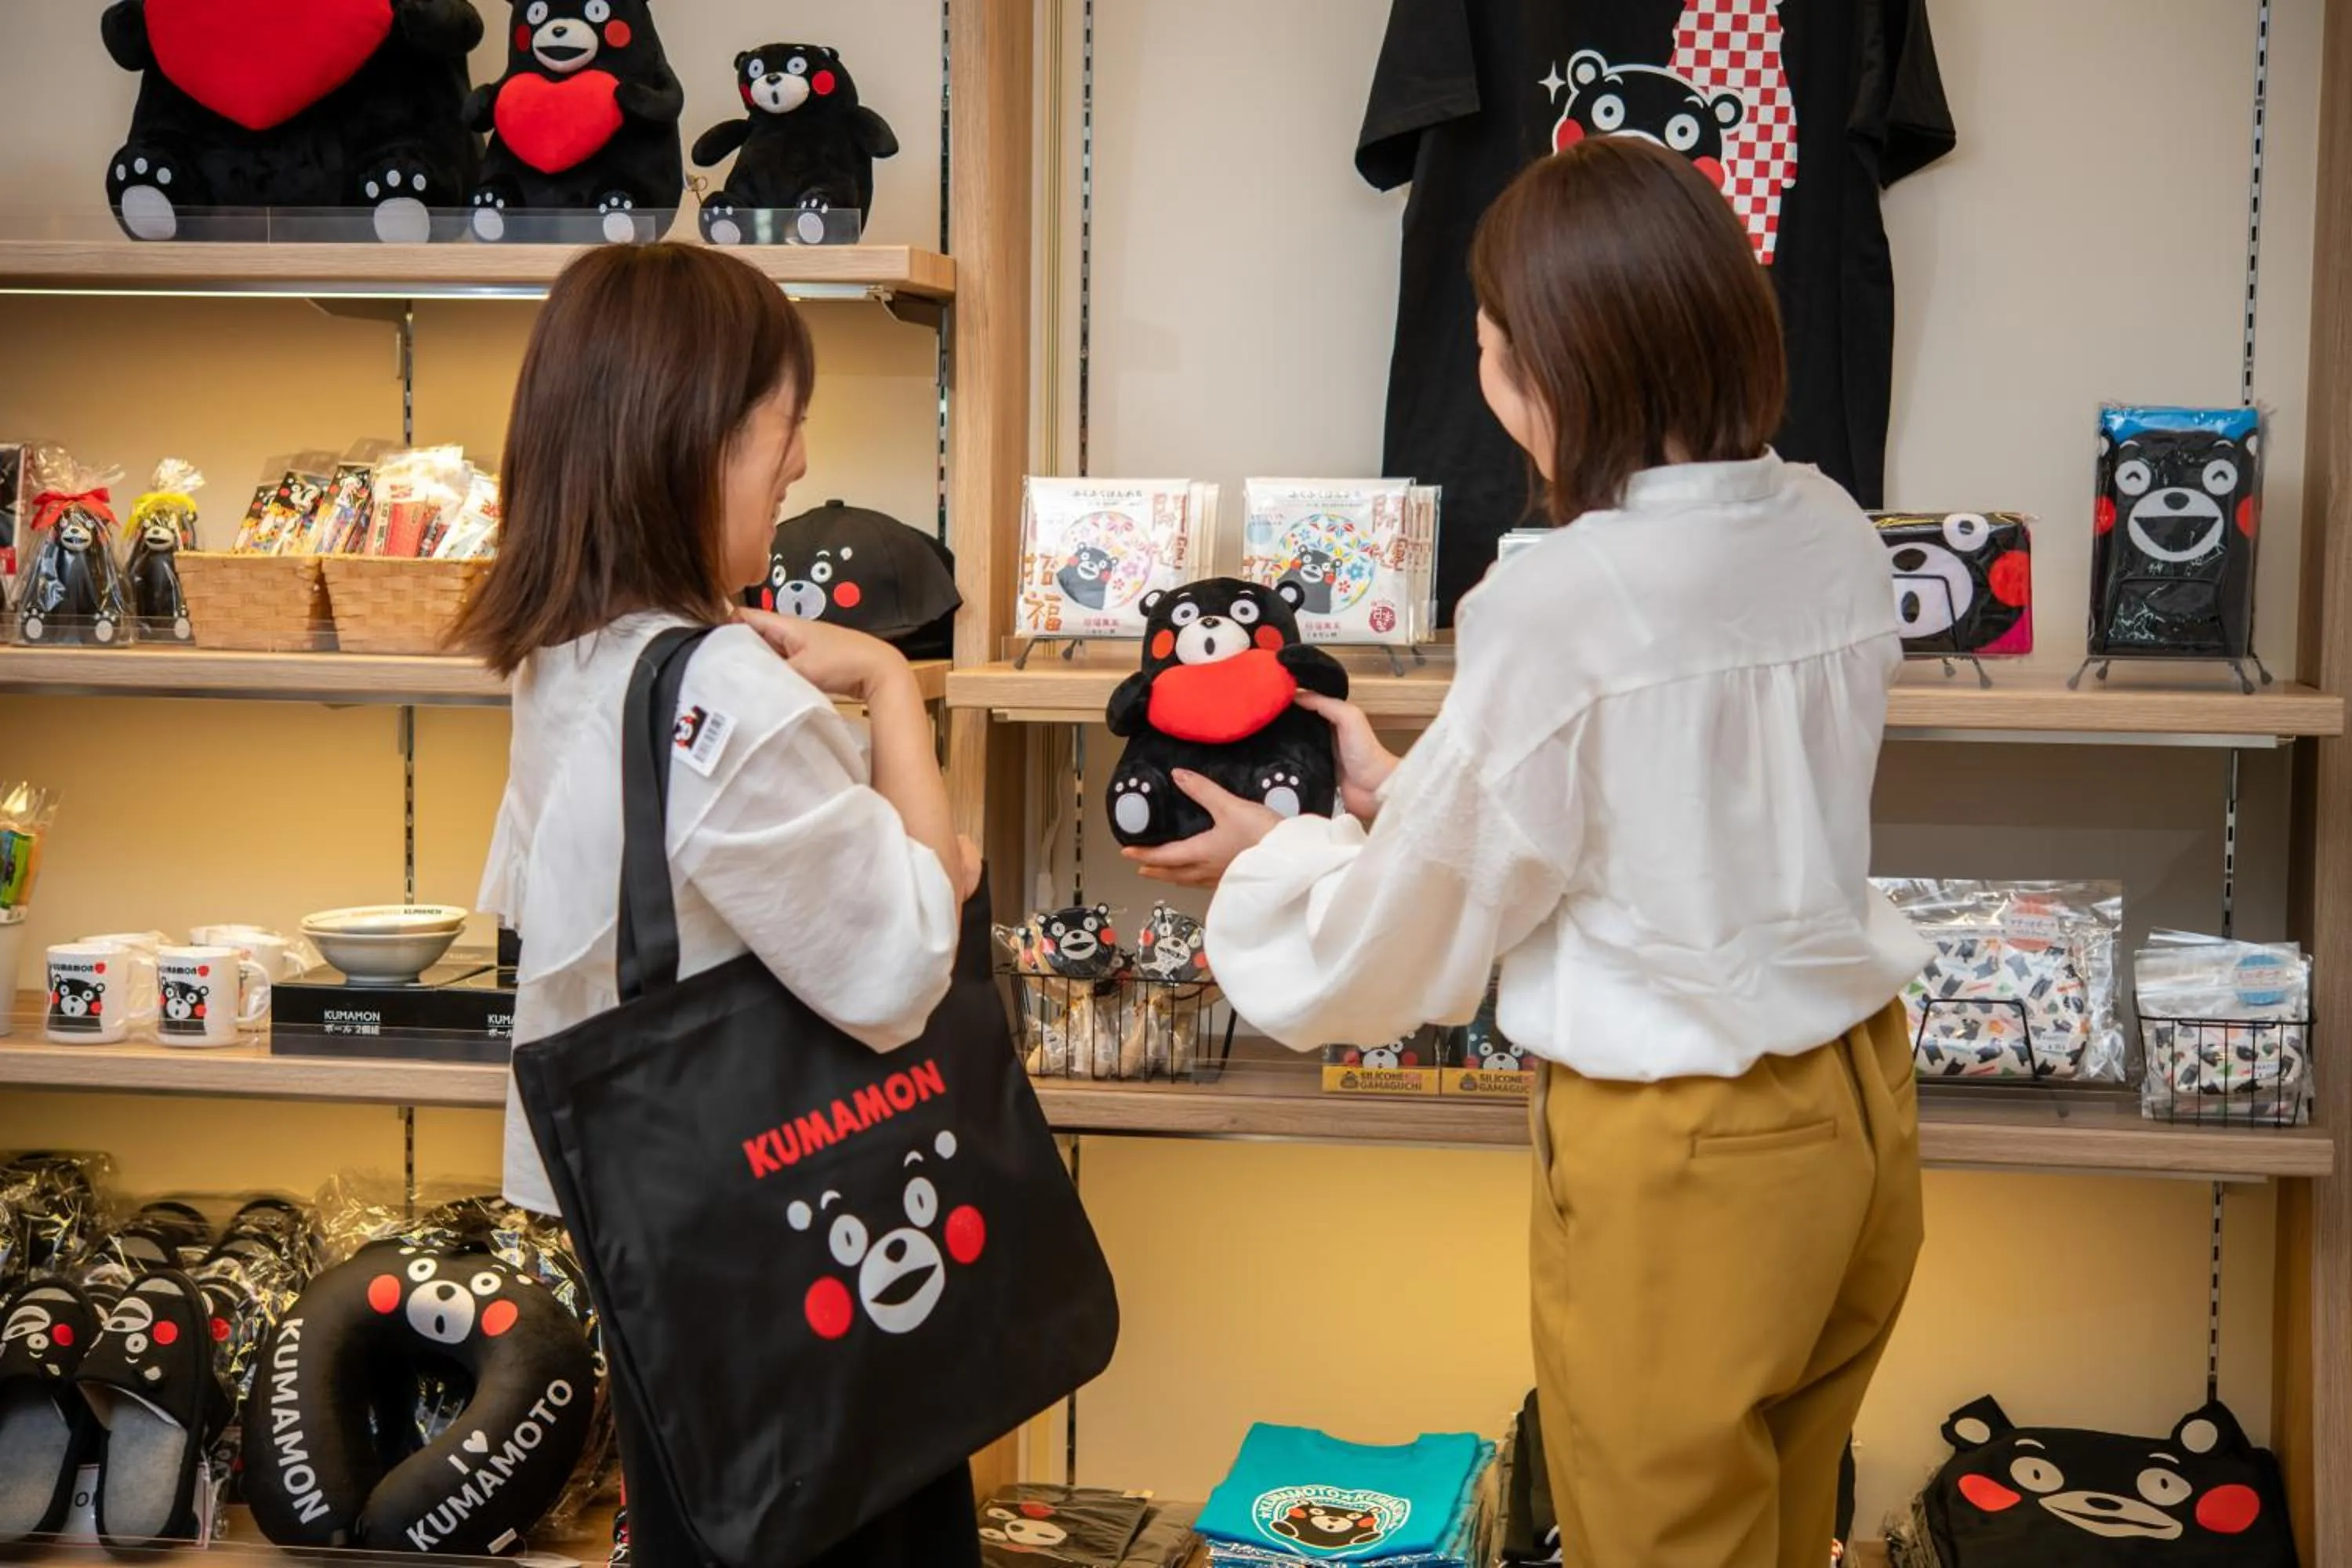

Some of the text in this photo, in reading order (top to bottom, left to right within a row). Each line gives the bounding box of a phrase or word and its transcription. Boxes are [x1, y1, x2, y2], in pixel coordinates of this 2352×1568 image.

[324, 1009, 380, 1022] KUMAMON
[325, 1024, 352, 1034] ボール
[1479, 1083, 1530, 1094] GAMAGUC
[742, 1058, 946, 1179] KUMAMON
[270, 1318, 332, 1525] KUMAMON
[405, 1378, 574, 1552] KUMAMOTO
[448, 1454, 470, 1476] I
